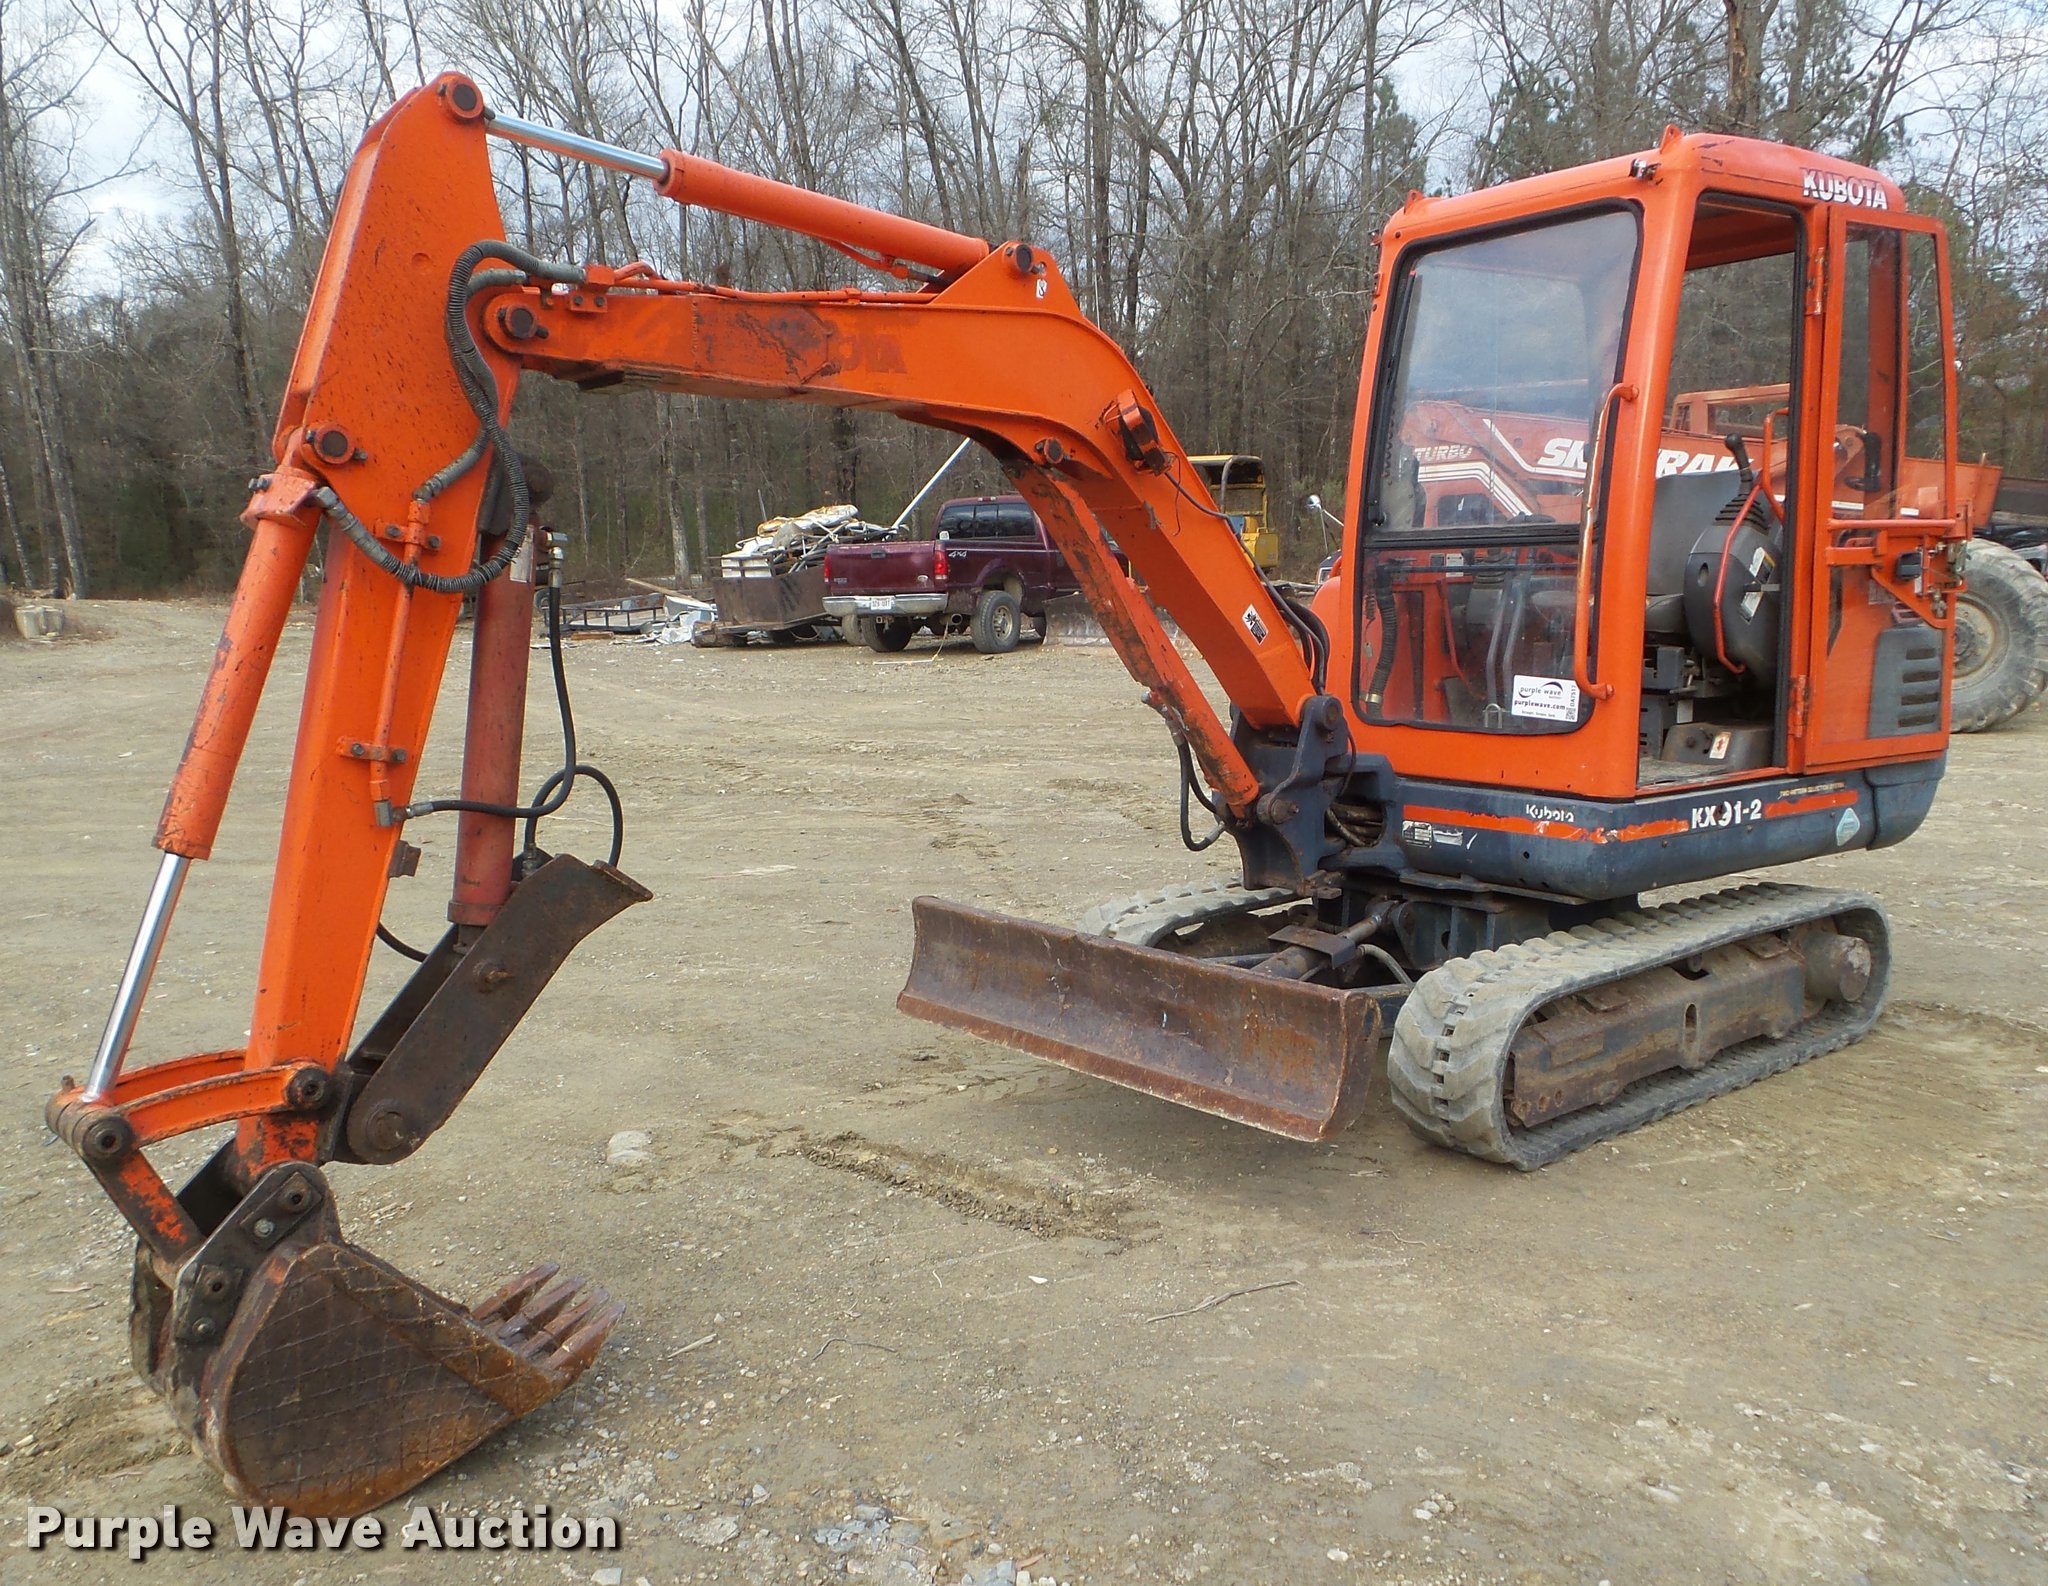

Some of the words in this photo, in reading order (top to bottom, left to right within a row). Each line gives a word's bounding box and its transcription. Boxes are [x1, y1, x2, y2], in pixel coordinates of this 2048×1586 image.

[1803, 168, 1888, 210] KUBOTA
[1414, 444, 1472, 461] TURBO
[1514, 699, 1566, 710] purplewave.com
